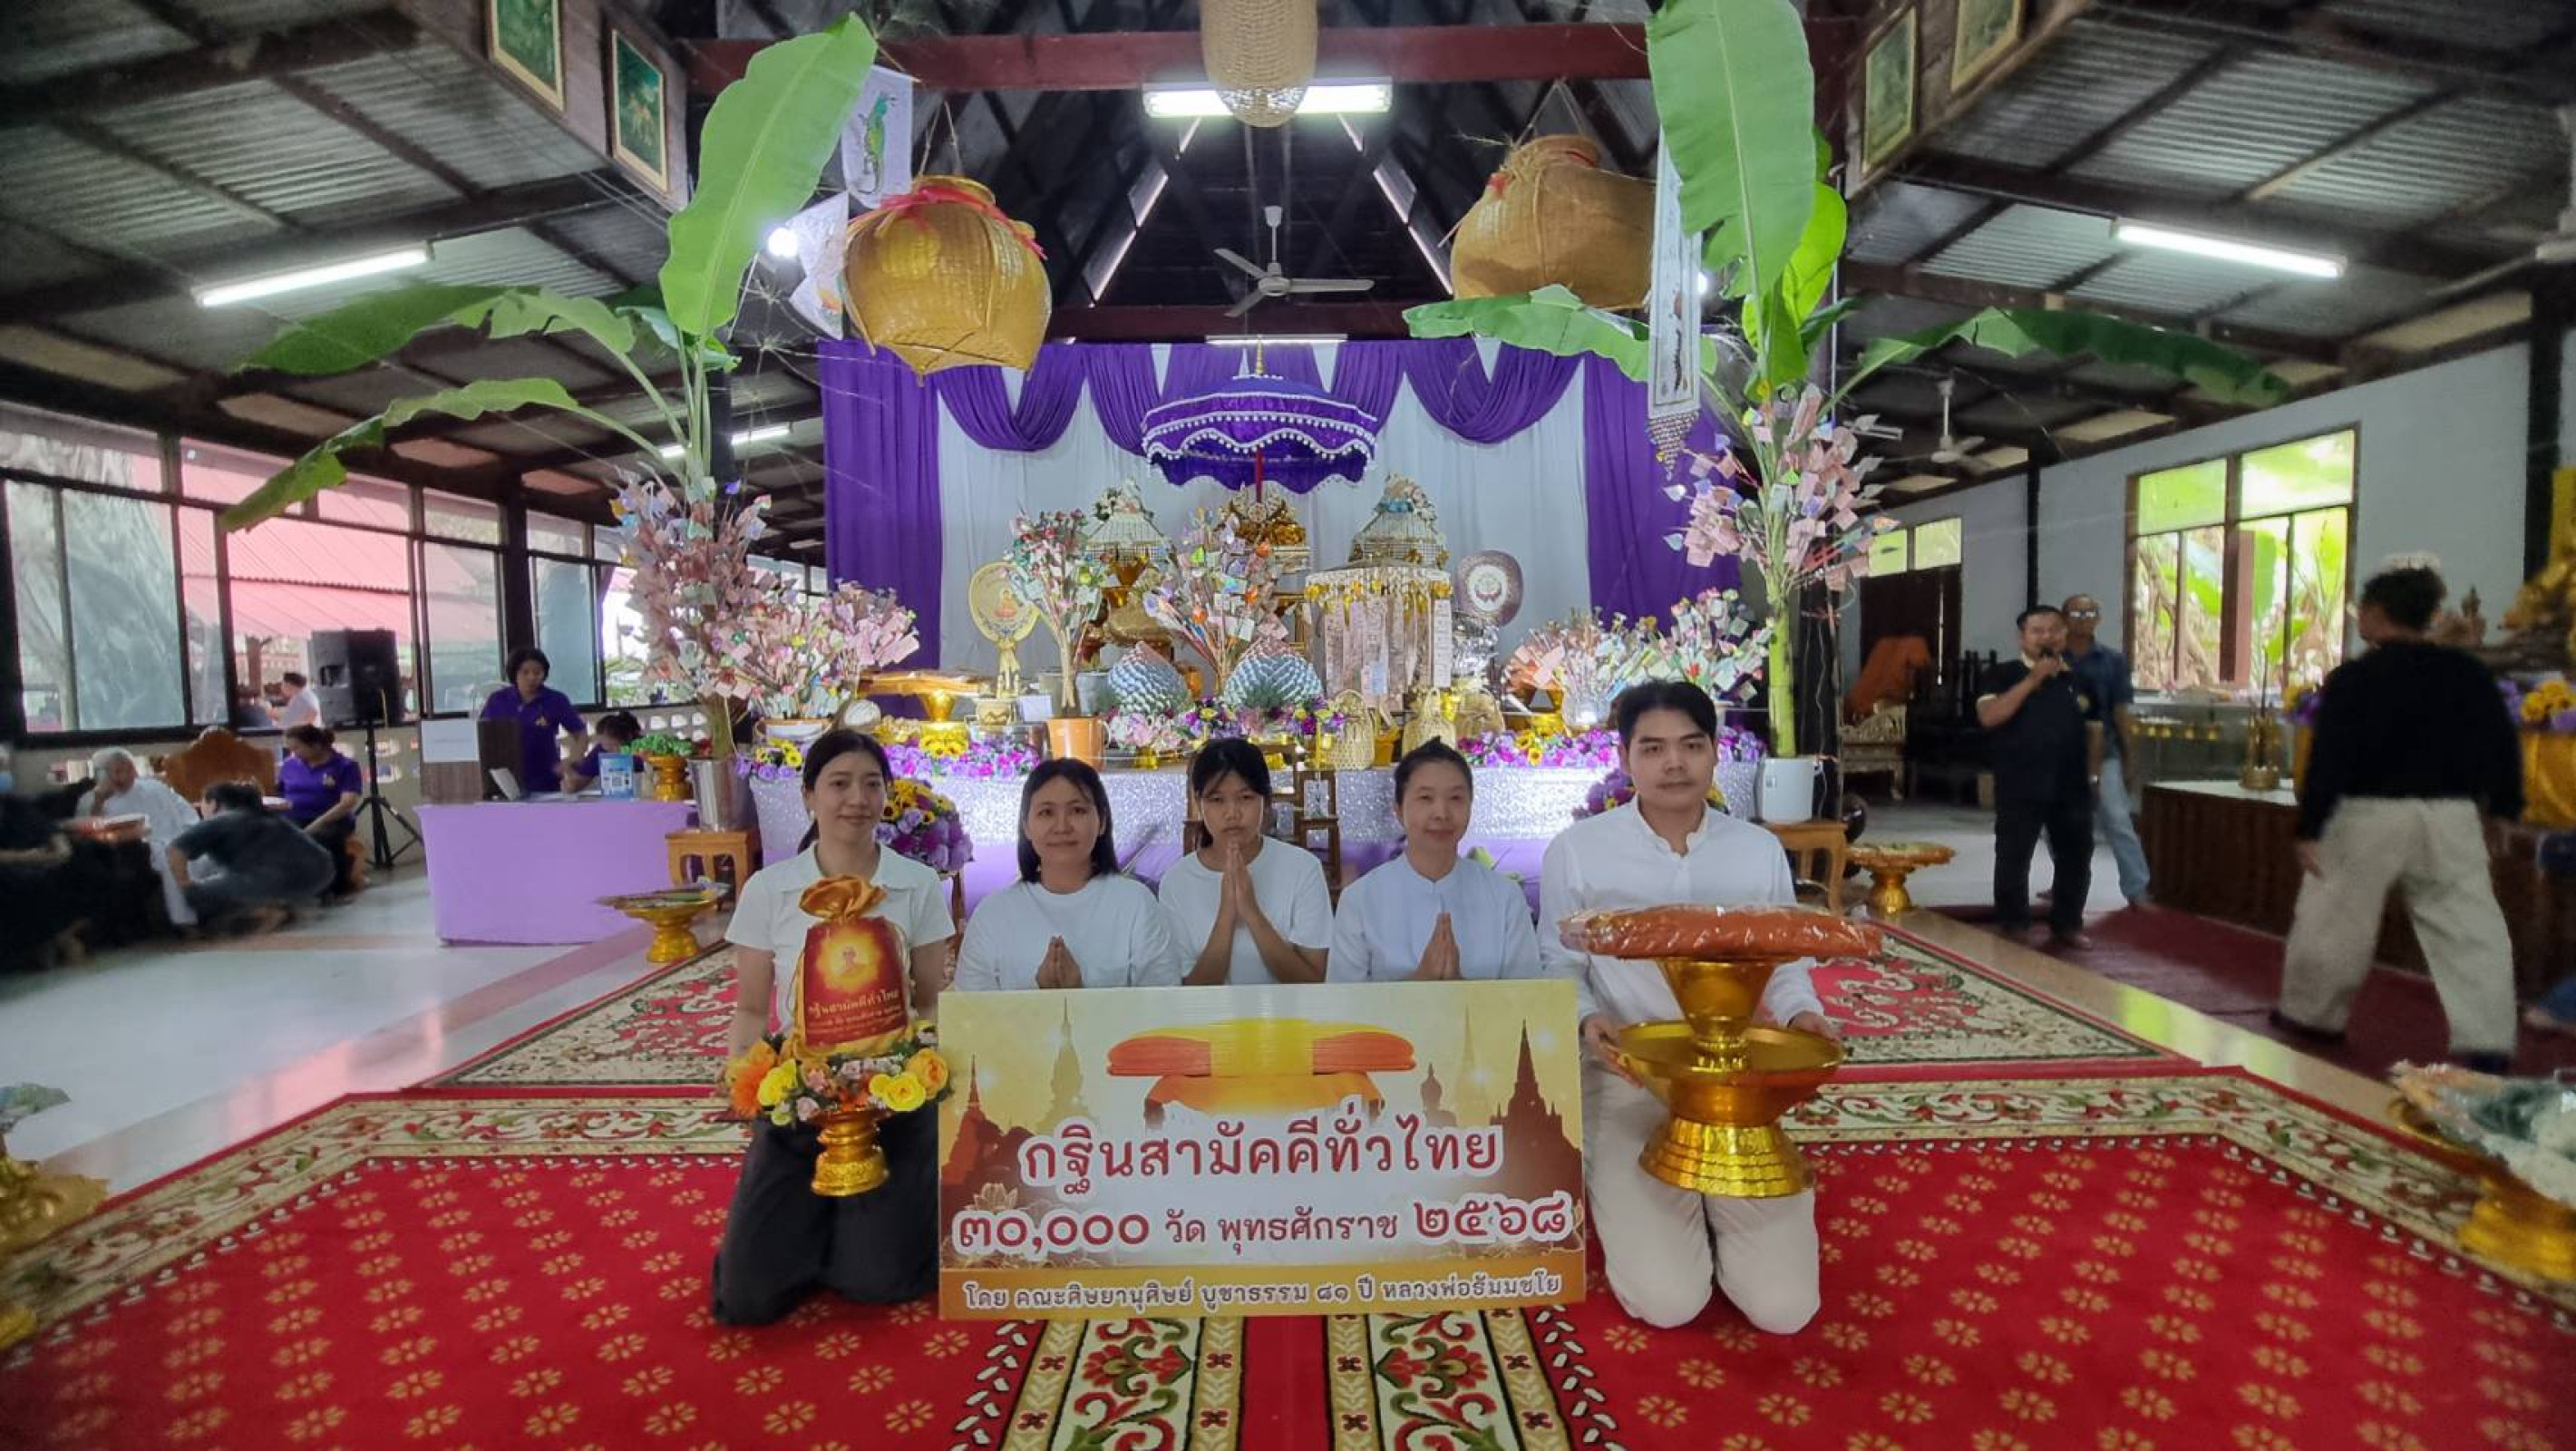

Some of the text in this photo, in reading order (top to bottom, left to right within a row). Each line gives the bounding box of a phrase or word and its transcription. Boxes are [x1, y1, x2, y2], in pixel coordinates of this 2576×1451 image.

[1026, 1101, 1496, 1194] กฐินสามัคคีทั่วไทย
[958, 1198, 1566, 1255] ๓๐,๐๐๐ วัด พุทธศักราช ๒๕๖๘
[966, 1283, 1006, 1307] โดย
[1016, 1277, 1192, 1310] คณะศิษยานุศิษย์
[1201, 1285, 1307, 1311] บูชาธรรม
[1357, 1275, 1373, 1300] ปี
[1383, 1270, 1560, 1299] หลวงพ่อธัมมชโย
